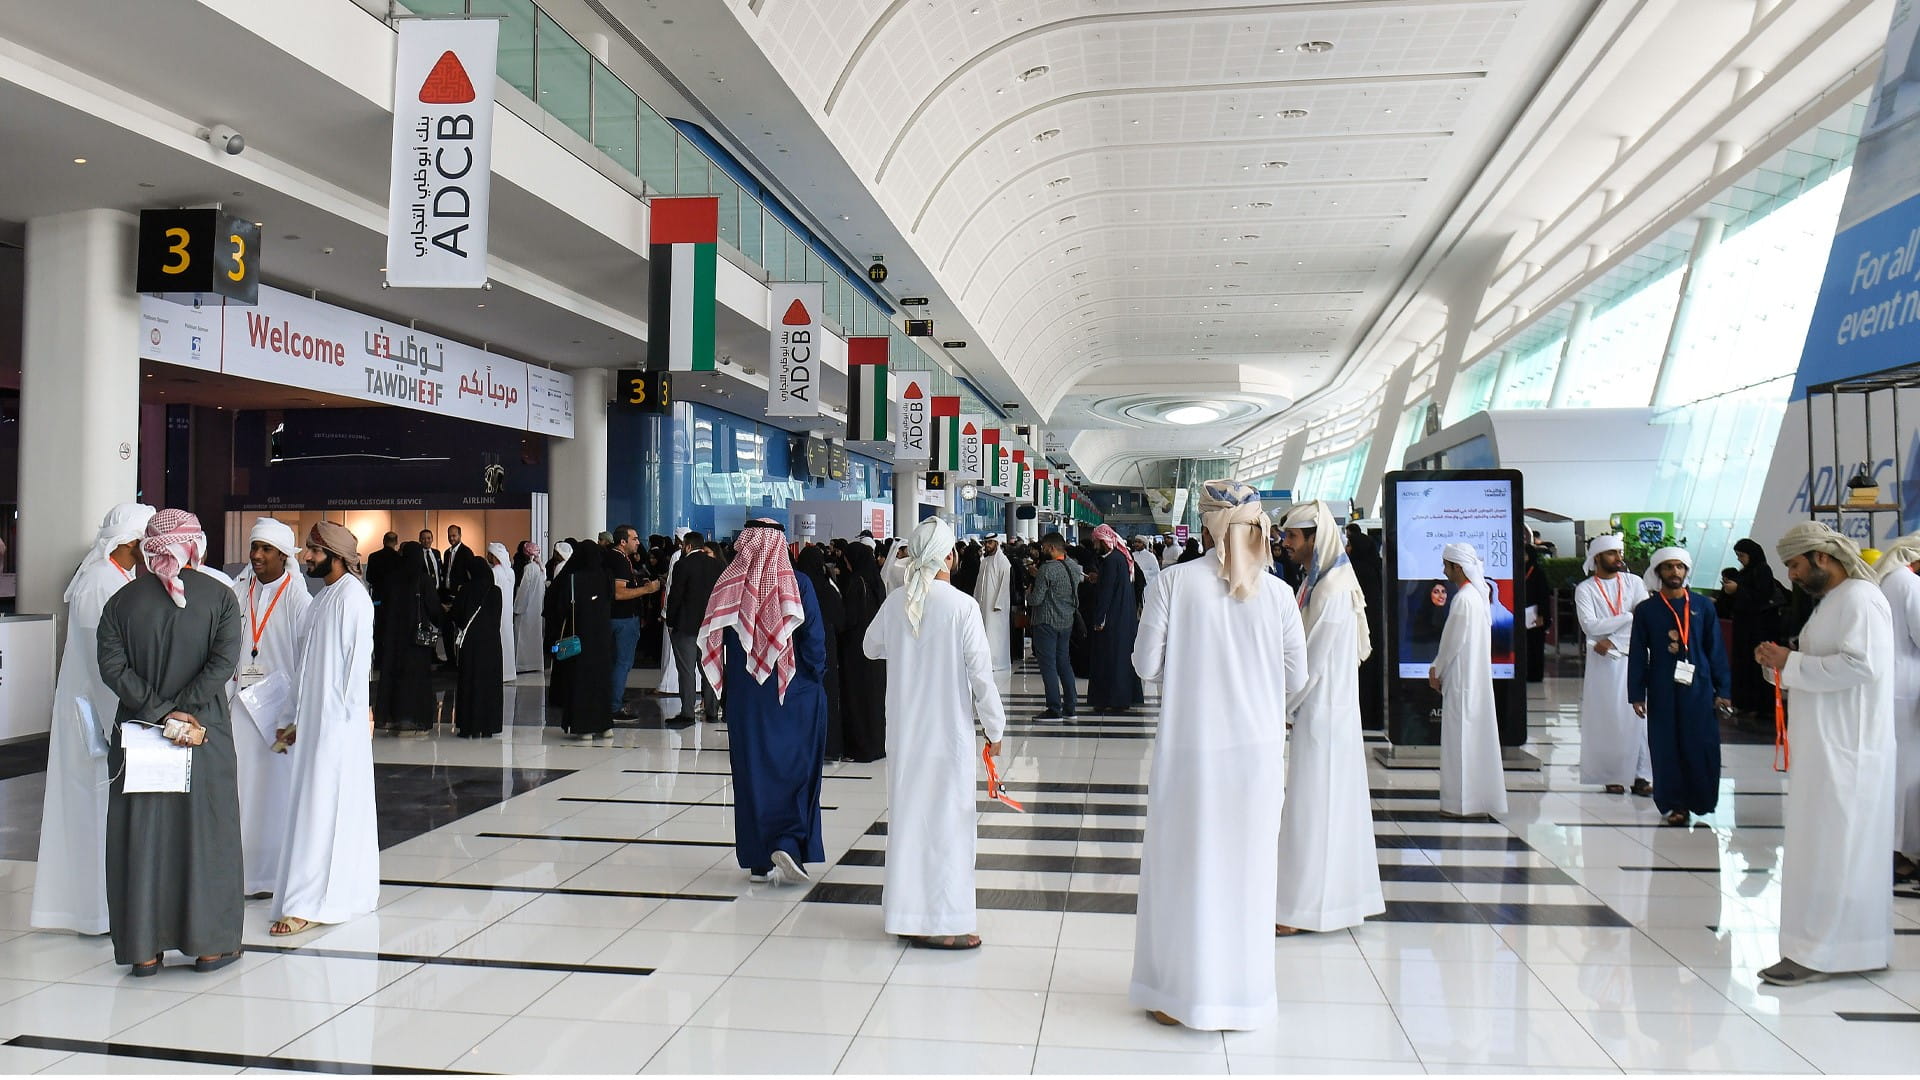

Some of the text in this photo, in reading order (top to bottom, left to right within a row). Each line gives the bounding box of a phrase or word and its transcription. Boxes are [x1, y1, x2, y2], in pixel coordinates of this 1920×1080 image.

[411, 116, 433, 257] بنك أبوظبي التجاري
[432, 114, 474, 258] ADCB
[162, 227, 191, 275] 3
[227, 234, 245, 281] 3
[1849, 250, 1890, 295] For
[1837, 290, 1902, 345] event
[247, 311, 345, 366] Welcome
[790, 330, 811, 402] ADCB
[365, 367, 444, 406] TAWDHEEF
[459, 369, 483, 404] بكم
[630, 378, 646, 404] 3
[662, 381, 668, 406] 3
[909, 402, 922, 450] ADCB
[967, 437, 978, 473] ADCB
[1000, 459, 1009, 487] ADCB
[931, 475, 940, 487] 4
[462, 497, 496, 505] AIRLINK
[1491, 529, 1507, 540] يناير
[1491, 541, 1508, 553] 20
[1491, 551, 1508, 567] 20
